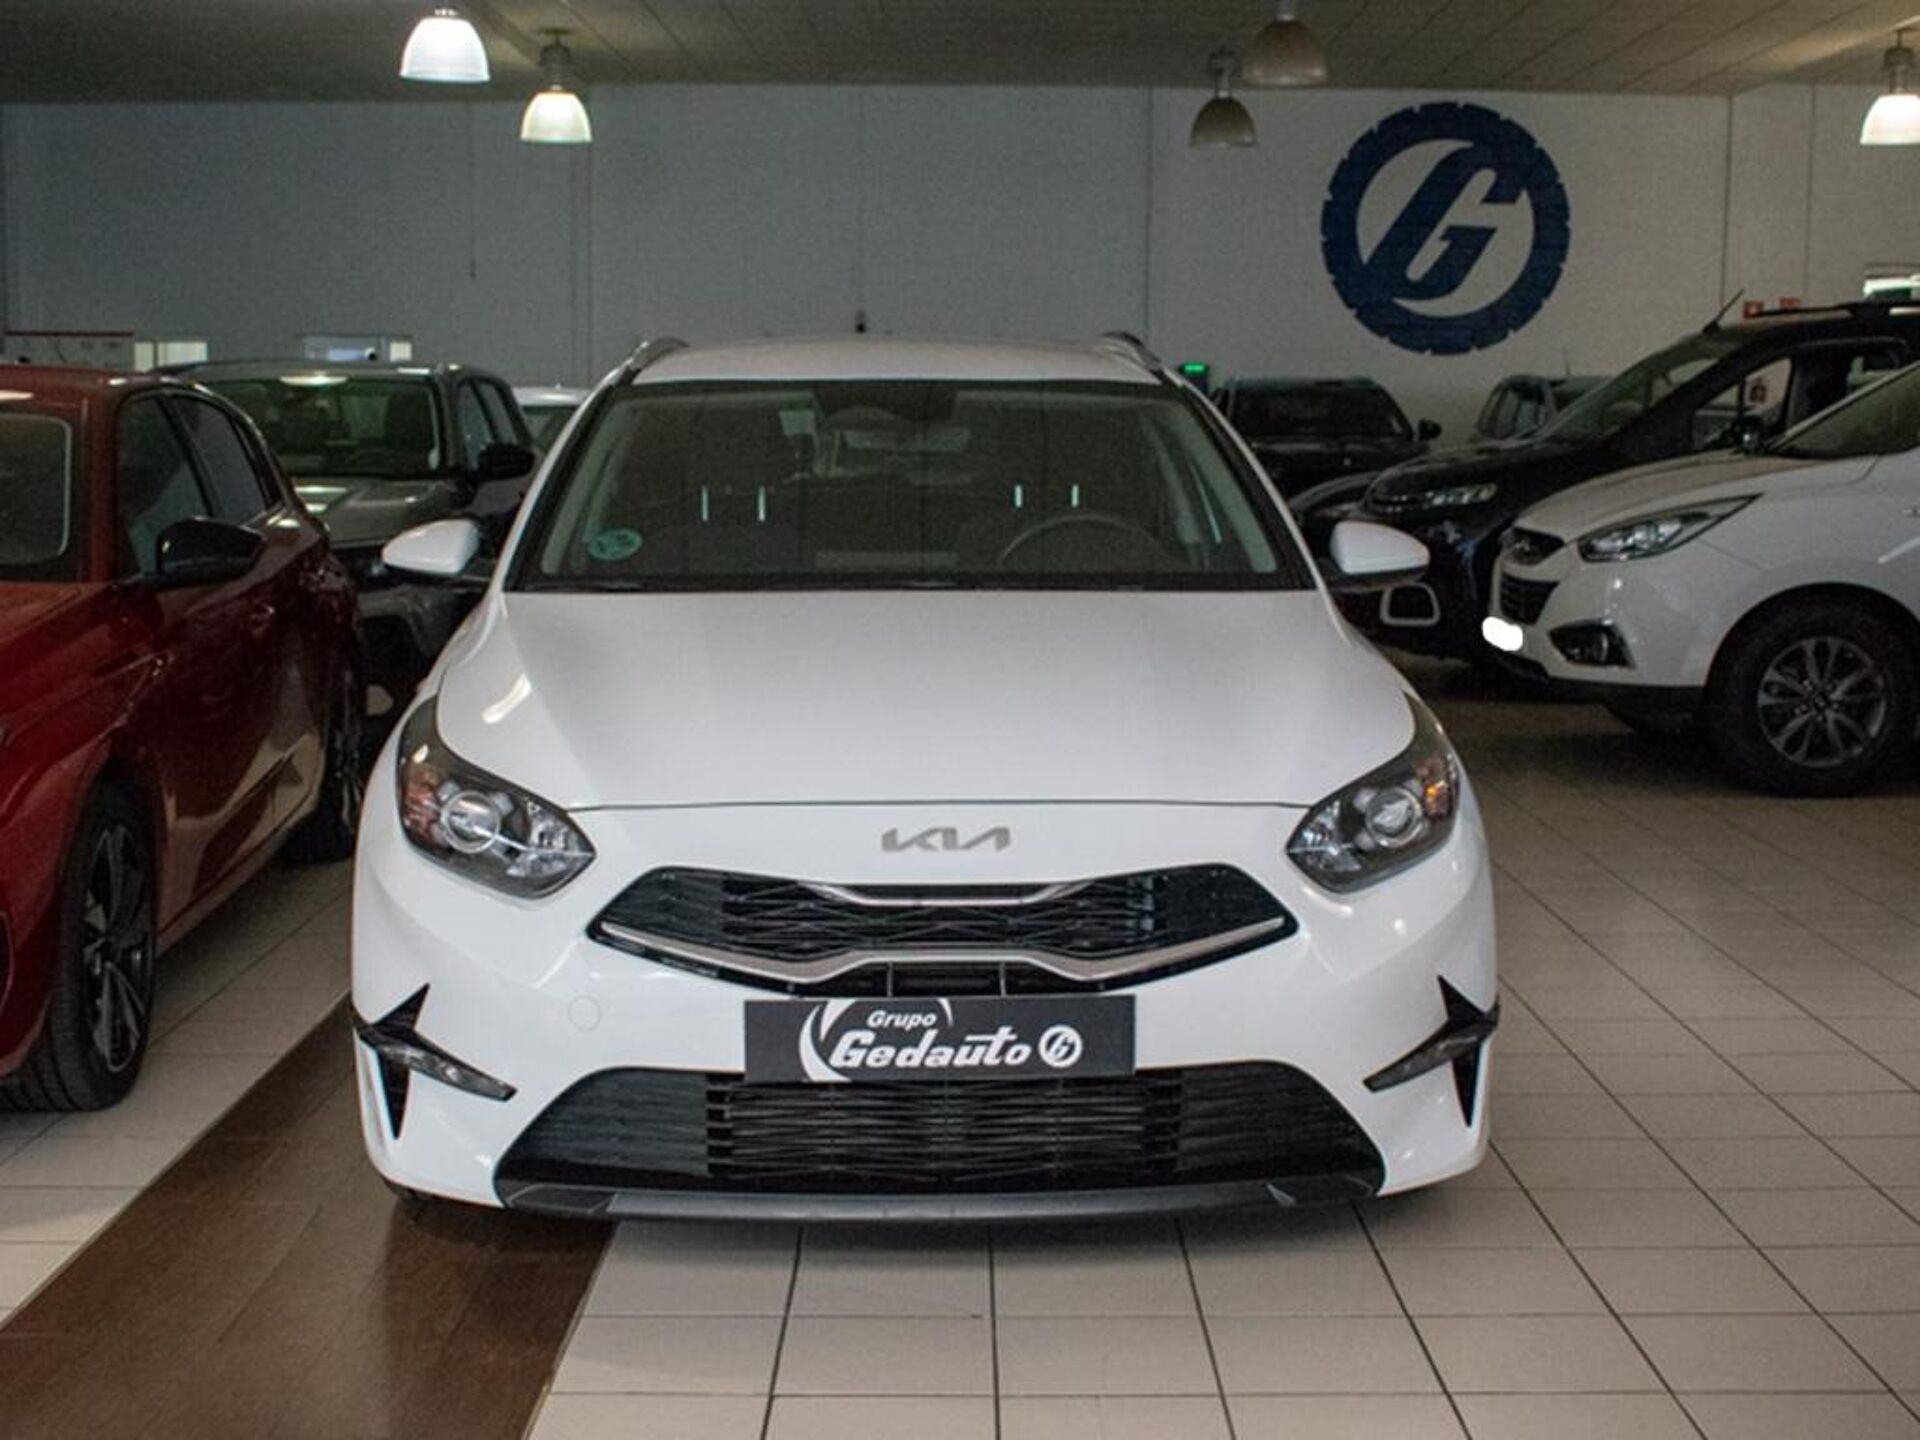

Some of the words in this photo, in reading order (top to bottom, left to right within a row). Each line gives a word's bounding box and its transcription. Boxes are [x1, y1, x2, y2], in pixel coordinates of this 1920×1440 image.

[881, 827, 1011, 852] KIA
[866, 1009, 938, 1031] Grupo
[828, 1025, 1033, 1069] Gedauto
